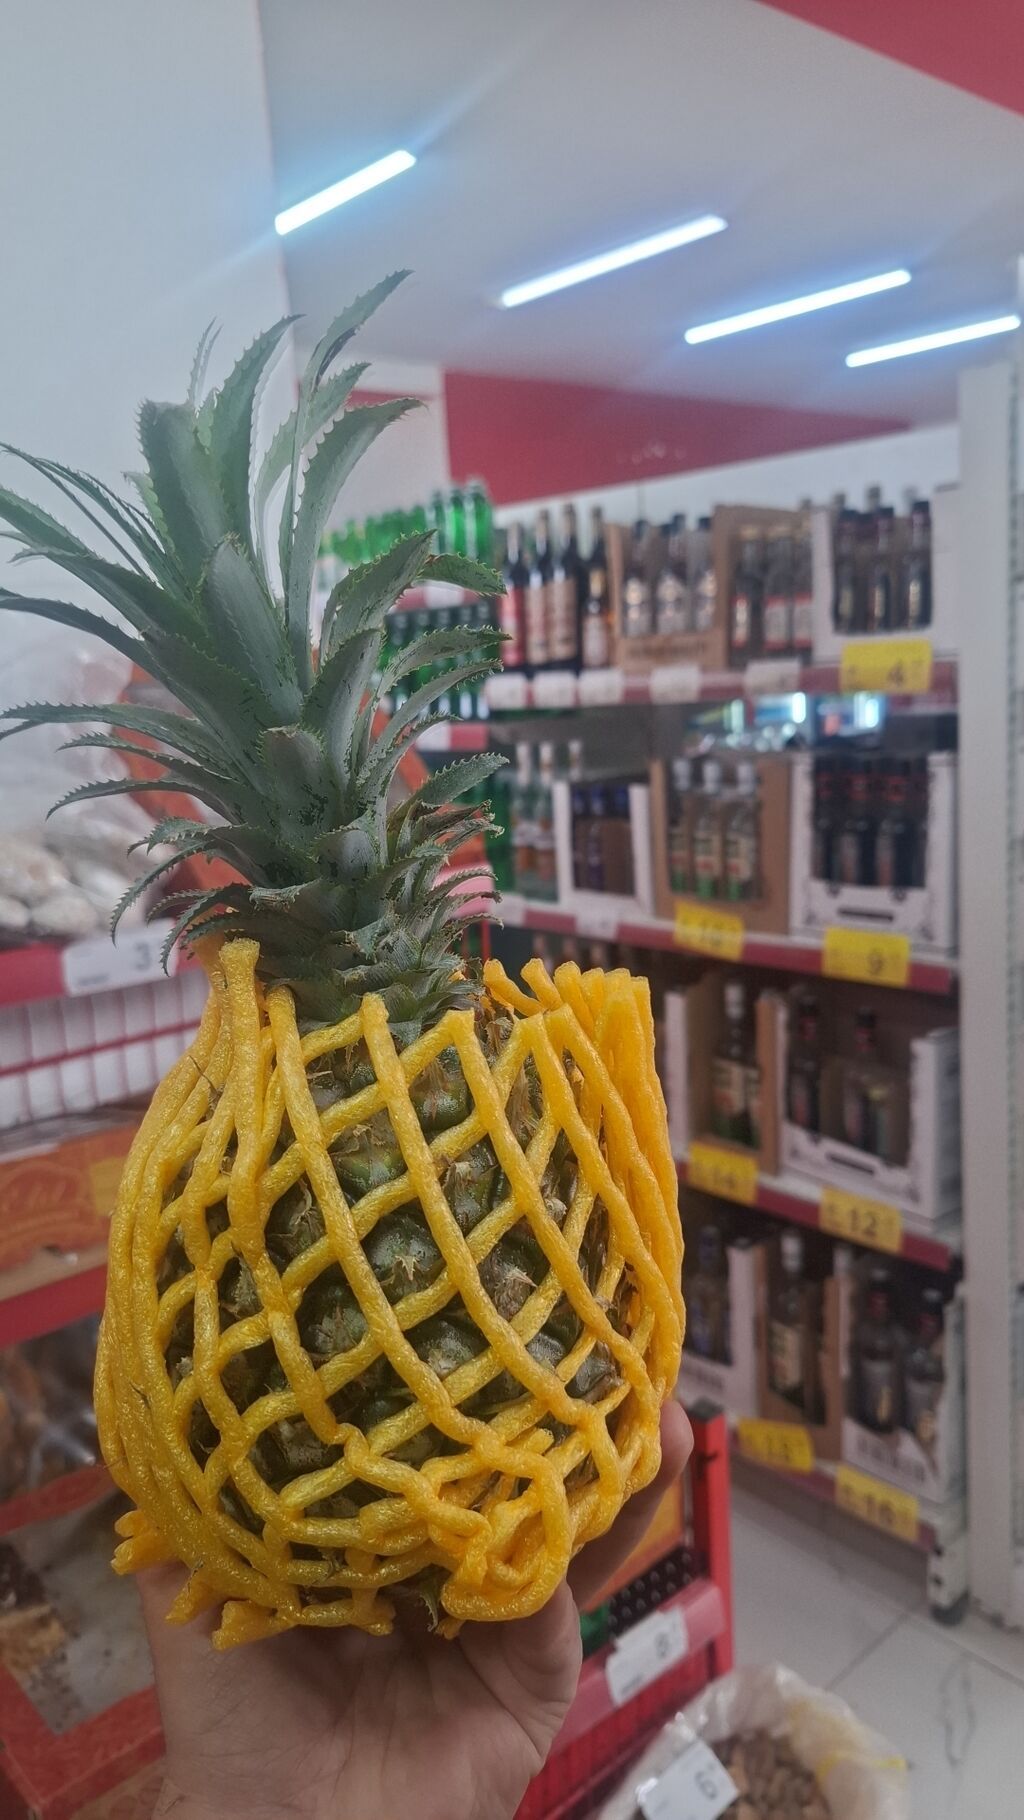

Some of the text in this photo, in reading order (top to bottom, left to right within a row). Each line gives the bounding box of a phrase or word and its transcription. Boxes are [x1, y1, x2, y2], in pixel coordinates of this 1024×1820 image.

[133, 942, 153, 972] 3
[850, 1207, 878, 1238] 12
[694, 1771, 718, 1801] 6
